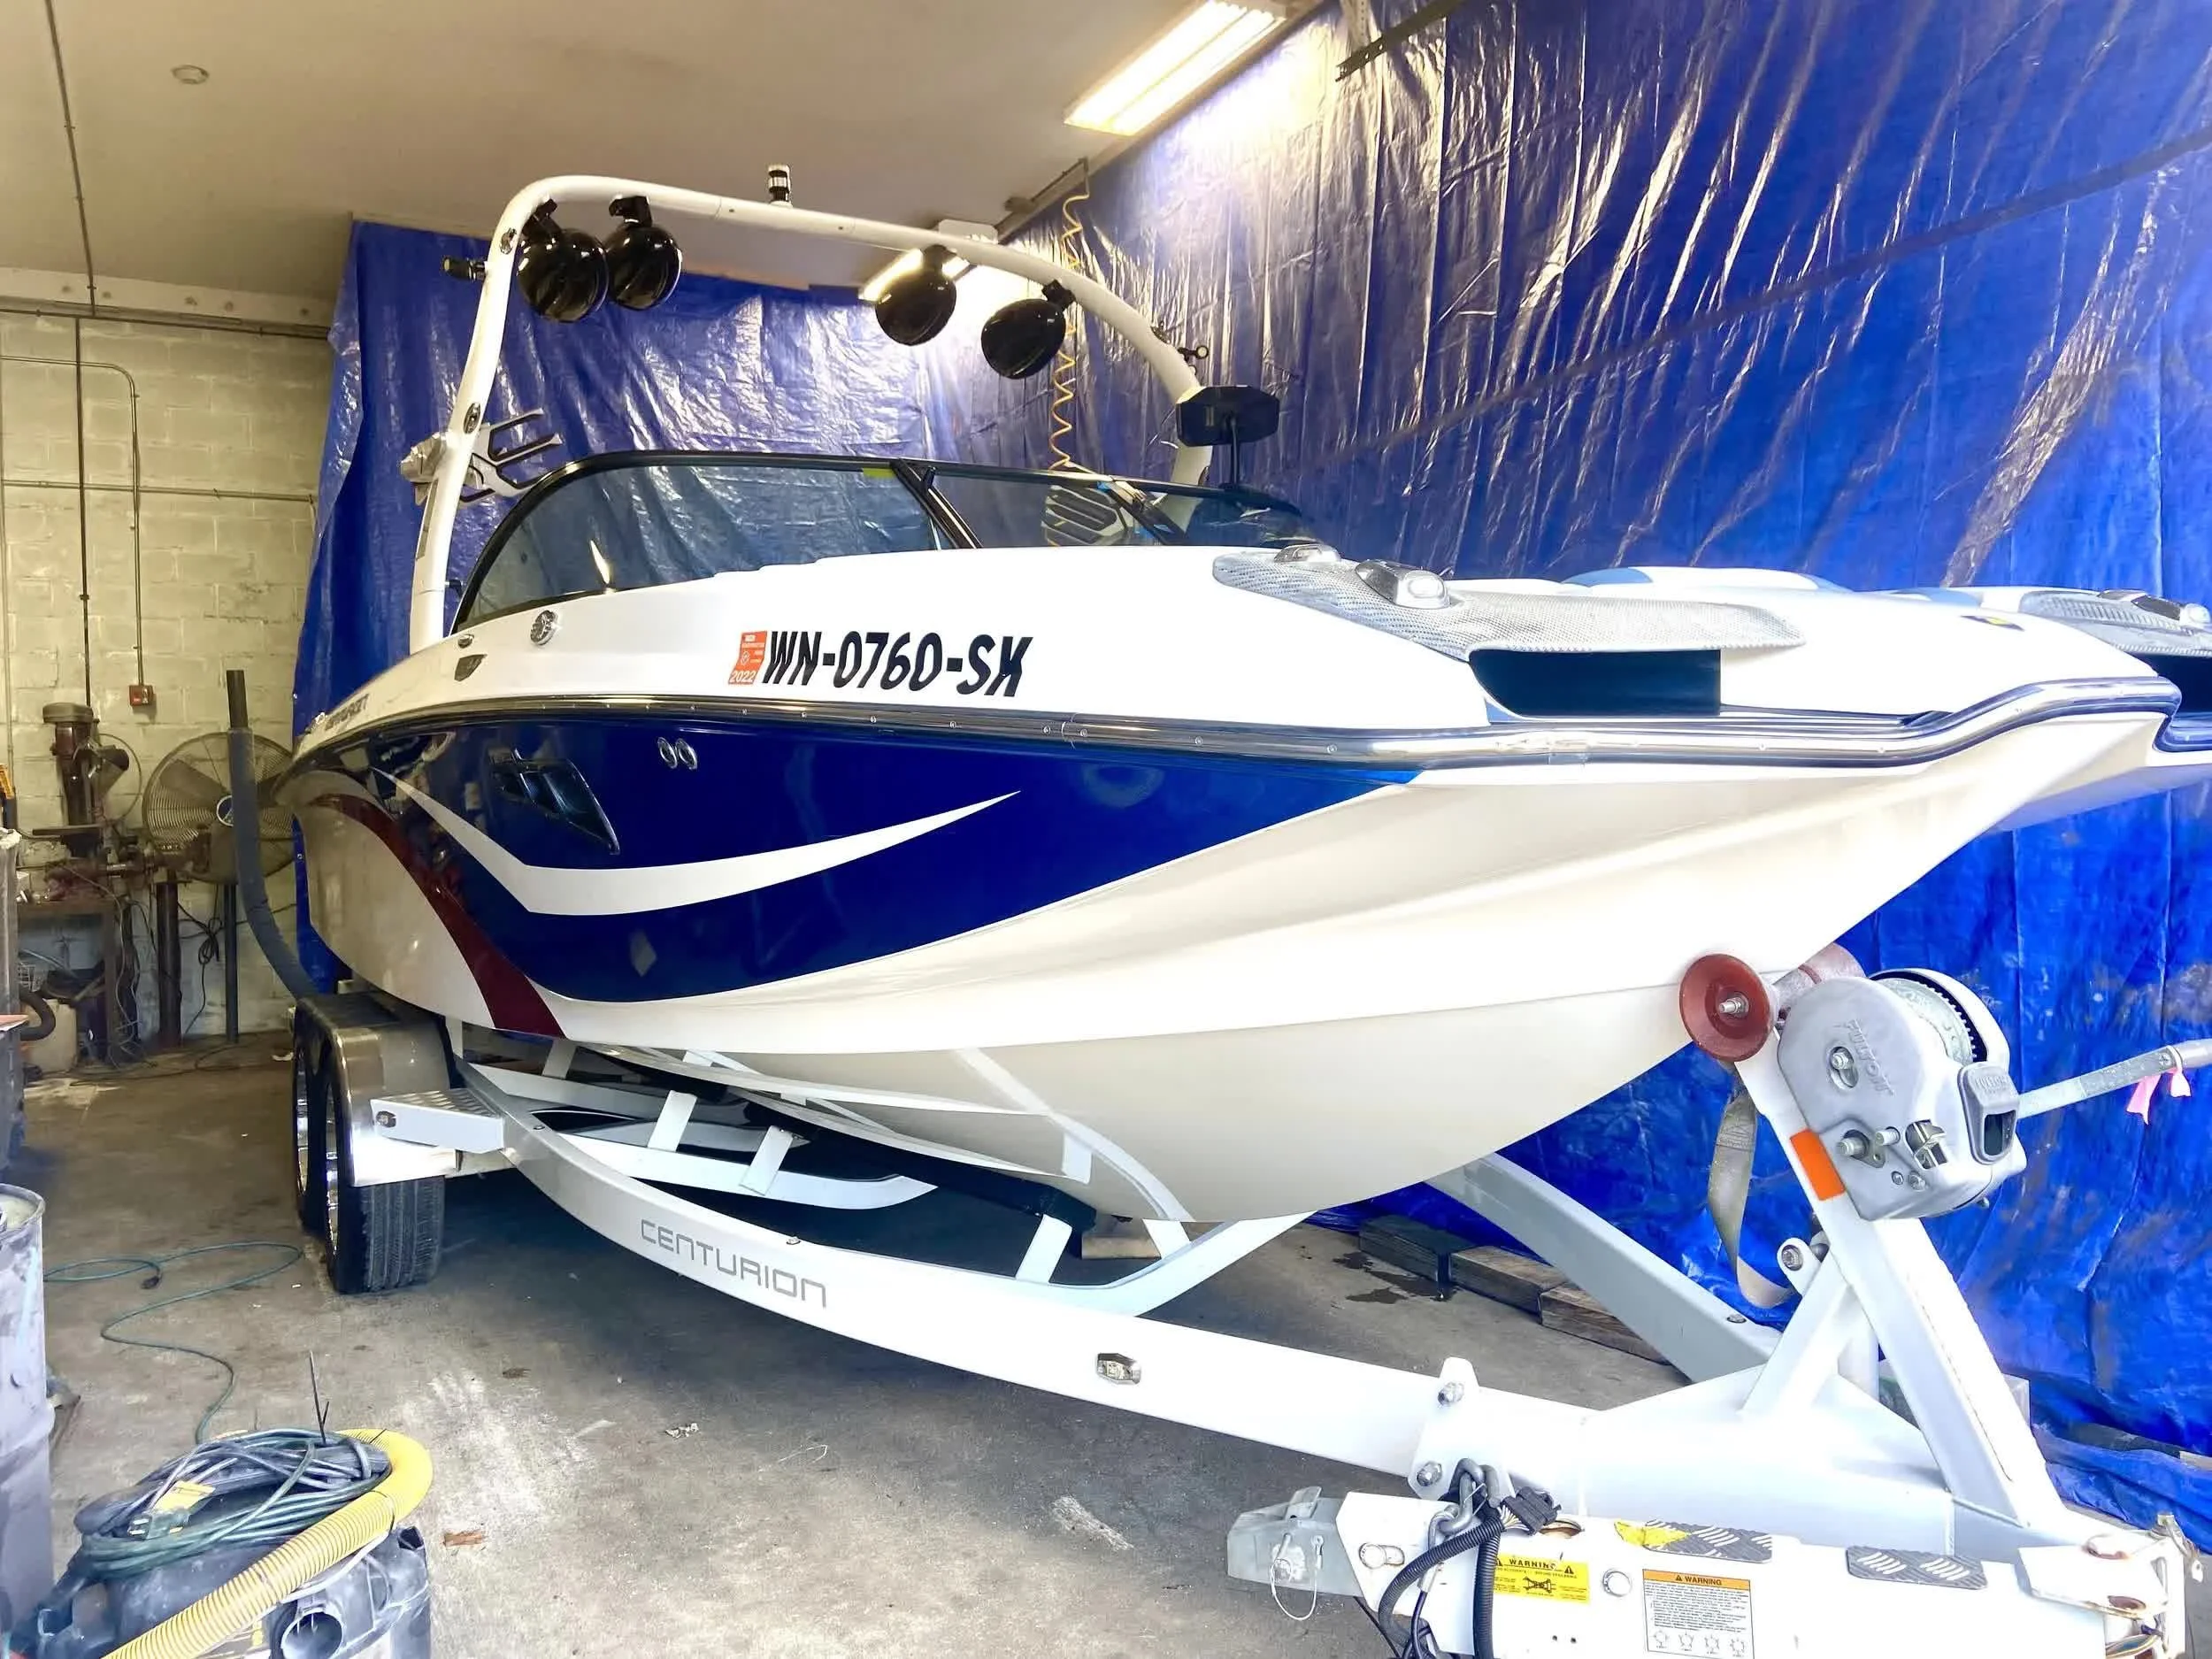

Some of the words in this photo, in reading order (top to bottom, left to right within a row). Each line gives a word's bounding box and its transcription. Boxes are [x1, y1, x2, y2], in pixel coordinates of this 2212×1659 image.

[763, 631, 1033, 696] WN-0760-SK
[1844, 1018, 1893, 1093] FULTON
[641, 1218, 826, 1309] CENTURION
[1509, 1558, 1556, 1570] WARNING
[1685, 1576, 1723, 1586] WARNING
